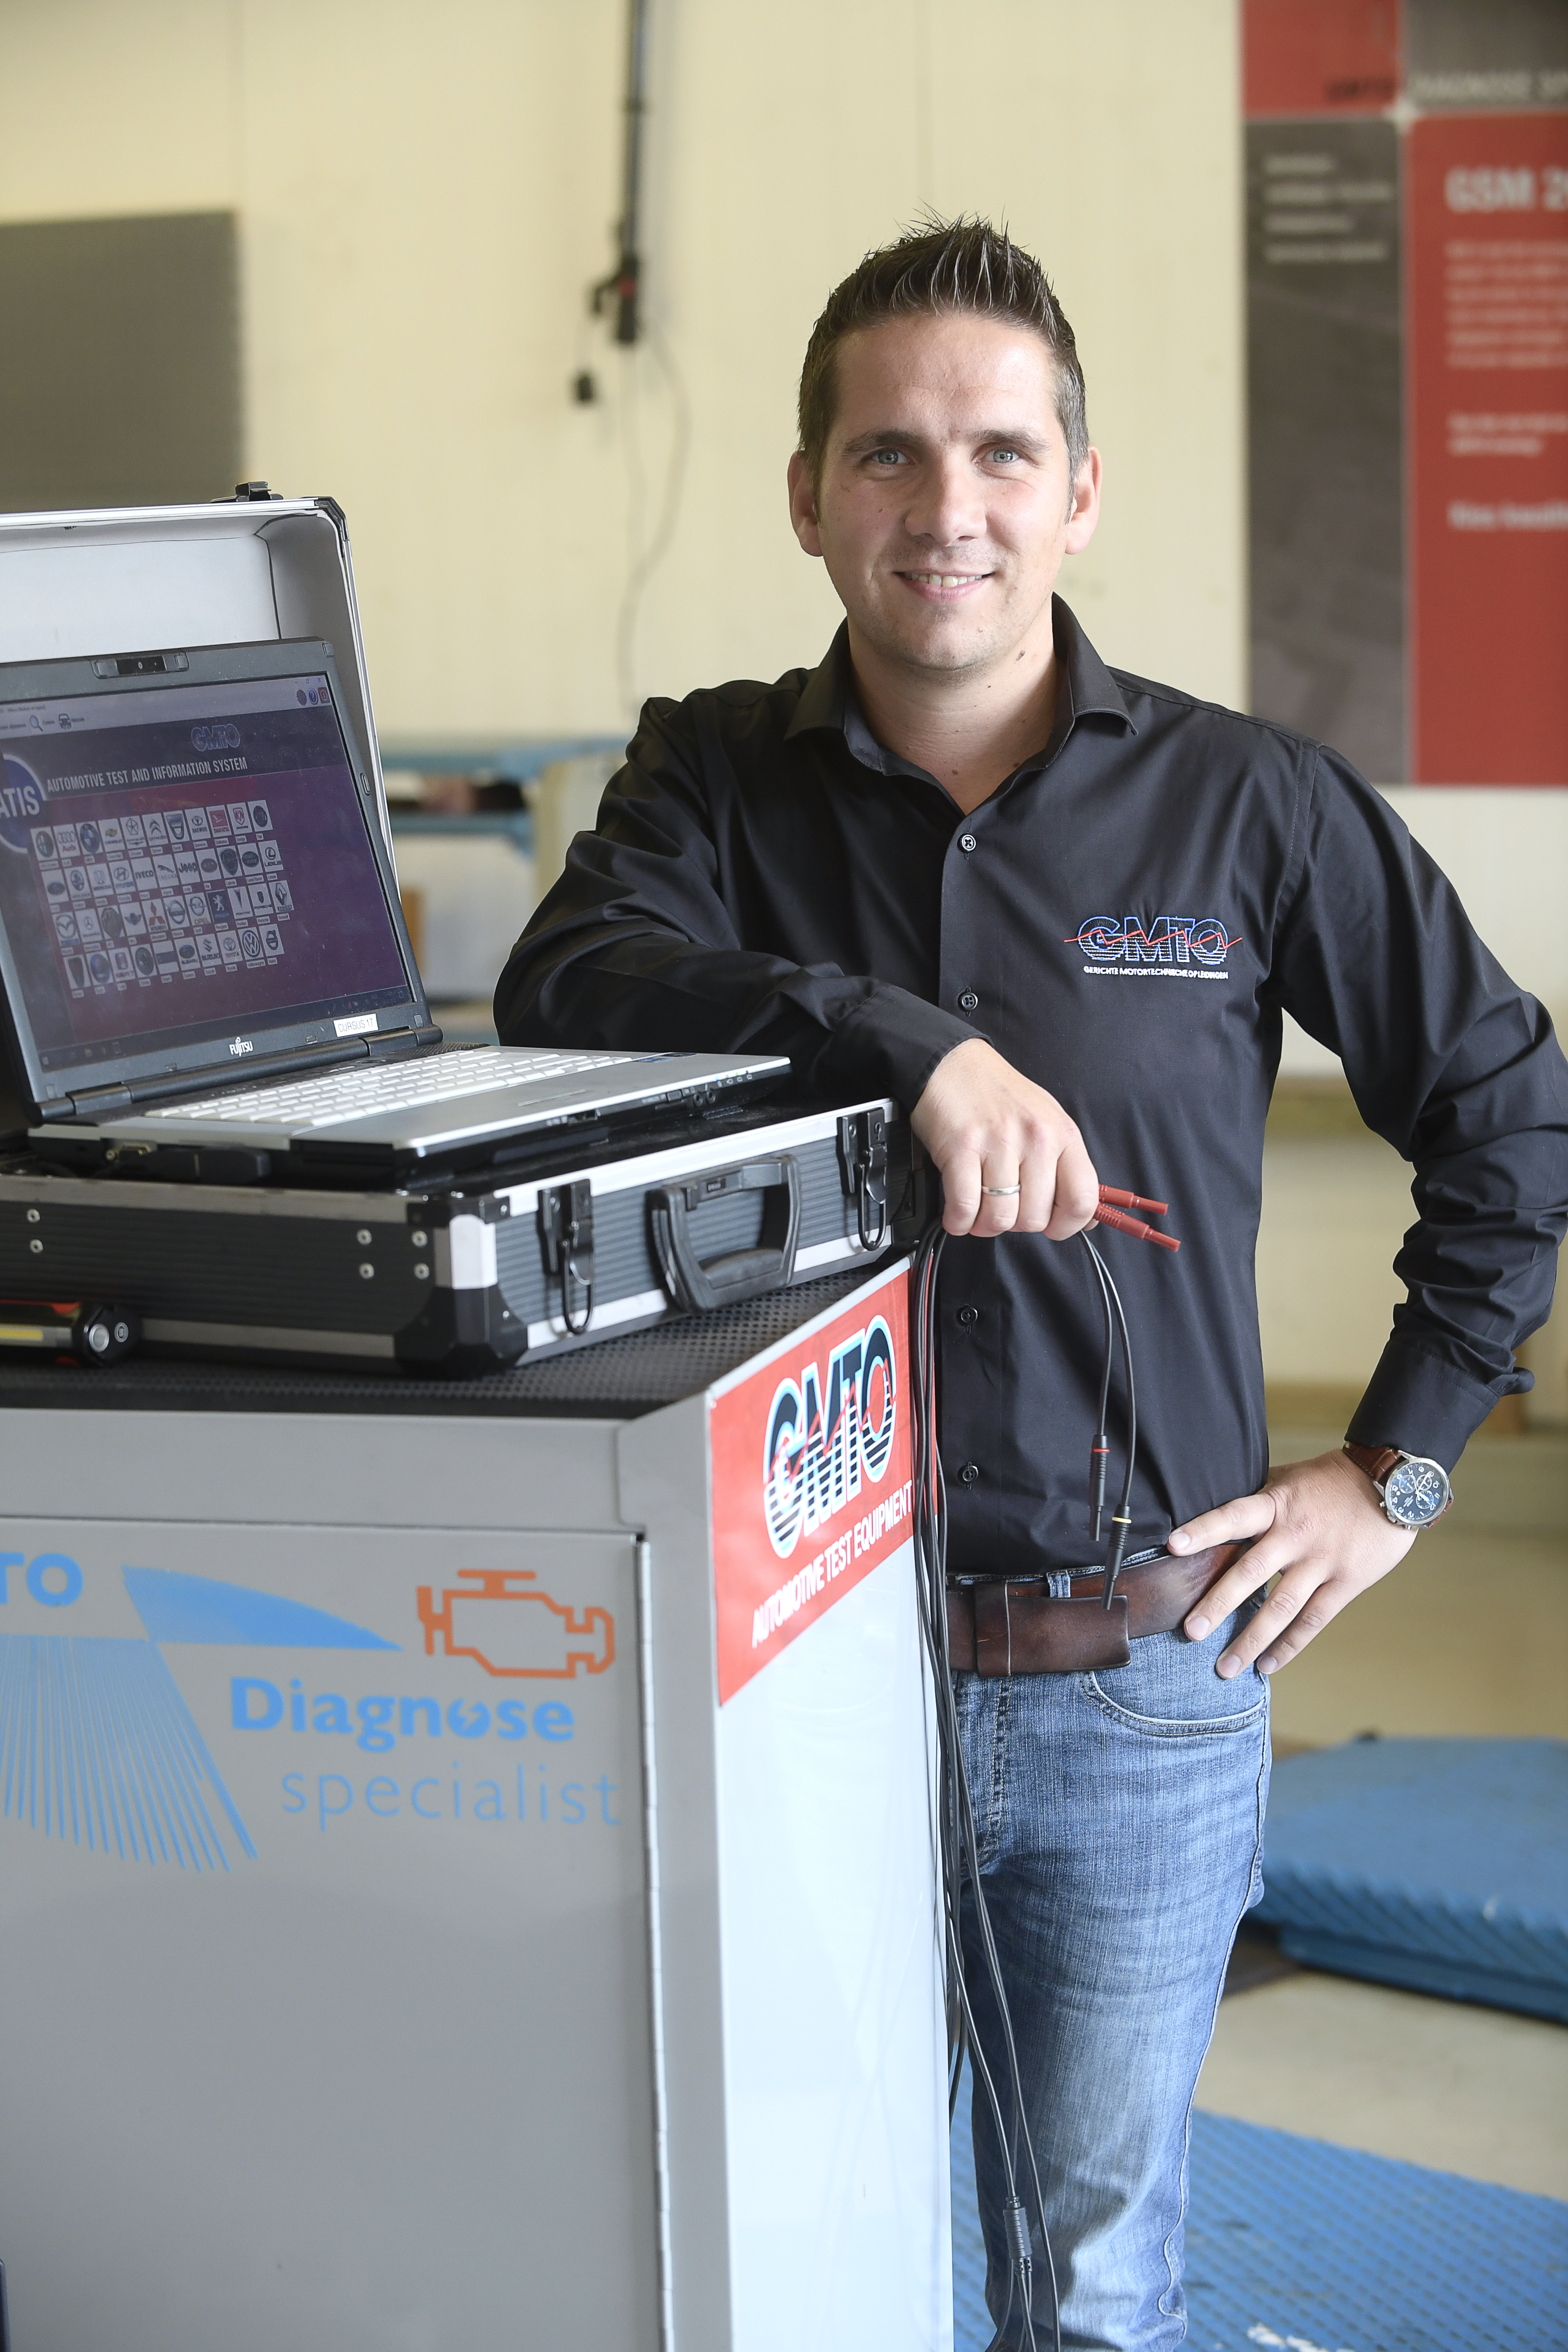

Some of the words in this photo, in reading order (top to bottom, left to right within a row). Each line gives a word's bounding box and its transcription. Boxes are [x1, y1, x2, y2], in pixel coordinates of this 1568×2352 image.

[1446, 166, 1535, 212] GSM
[47, 773, 105, 792] AUTOMOTIVE
[106, 770, 128, 785] TEST
[131, 768, 150, 782] AND
[152, 761, 212, 780] INFORMATION
[213, 757, 248, 773] SYSTEM
[135, 870, 154, 879] IVECO
[179, 863, 199, 873] Jeep
[1078, 916, 1228, 965] GMTO
[1083, 966, 1119, 975] GERICHTE
[338, 1019, 365, 1032] CURSUS
[367, 1018, 373, 1027] 17
[229, 1037, 253, 1056] FUJITSU
[763, 1315, 897, 1560] GMTO
[751, 1553, 825, 1649] AUTOMOTIVE
[824, 1529, 852, 1582] TEST
[854, 1479, 912, 1559] EQUIPMENT
[230, 1676, 575, 1753] Diagnose
[282, 1761, 620, 1832] specialist
